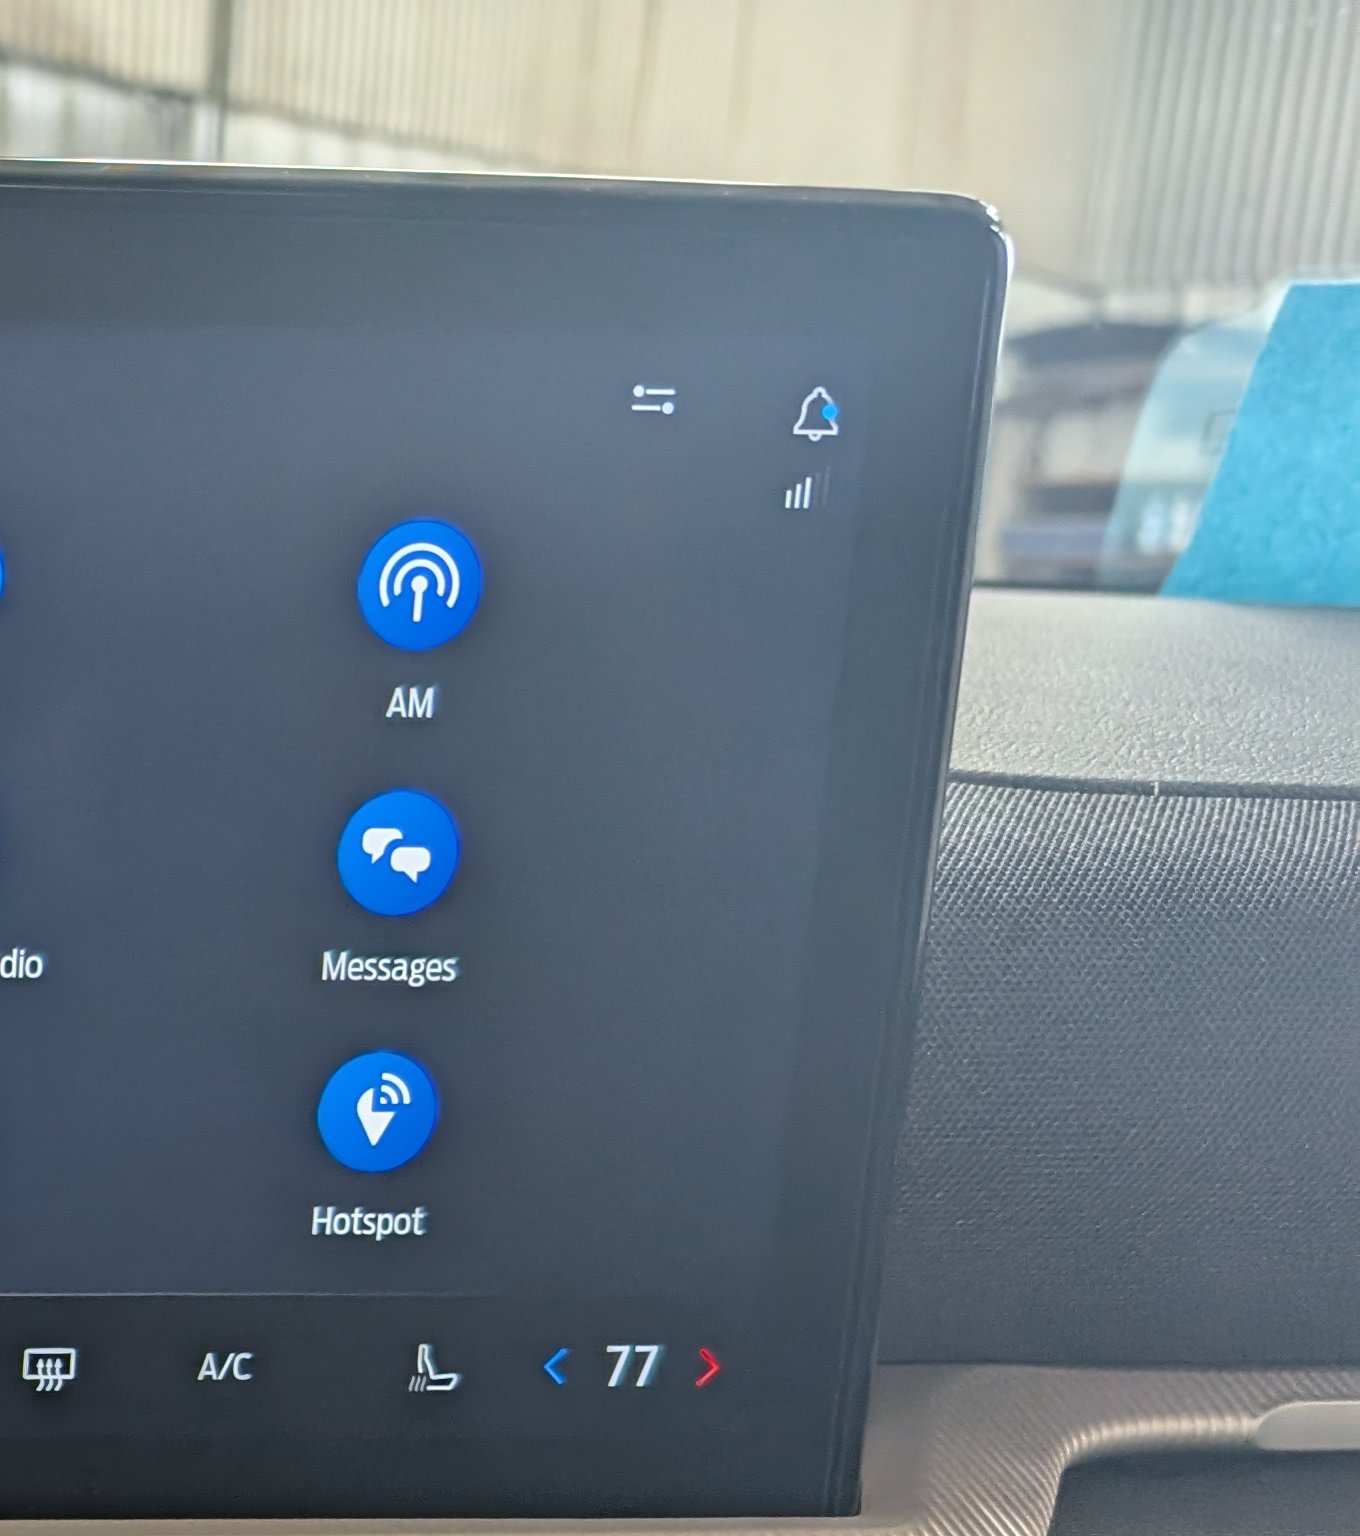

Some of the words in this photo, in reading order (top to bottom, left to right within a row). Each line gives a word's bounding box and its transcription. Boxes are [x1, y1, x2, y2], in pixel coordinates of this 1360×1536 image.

[385, 686, 437, 719] AM
[321, 950, 458, 988] Messages
[311, 1206, 427, 1242] Hotspot
[197, 1352, 253, 1381] A/C
[606, 1344, 661, 1387] 77
